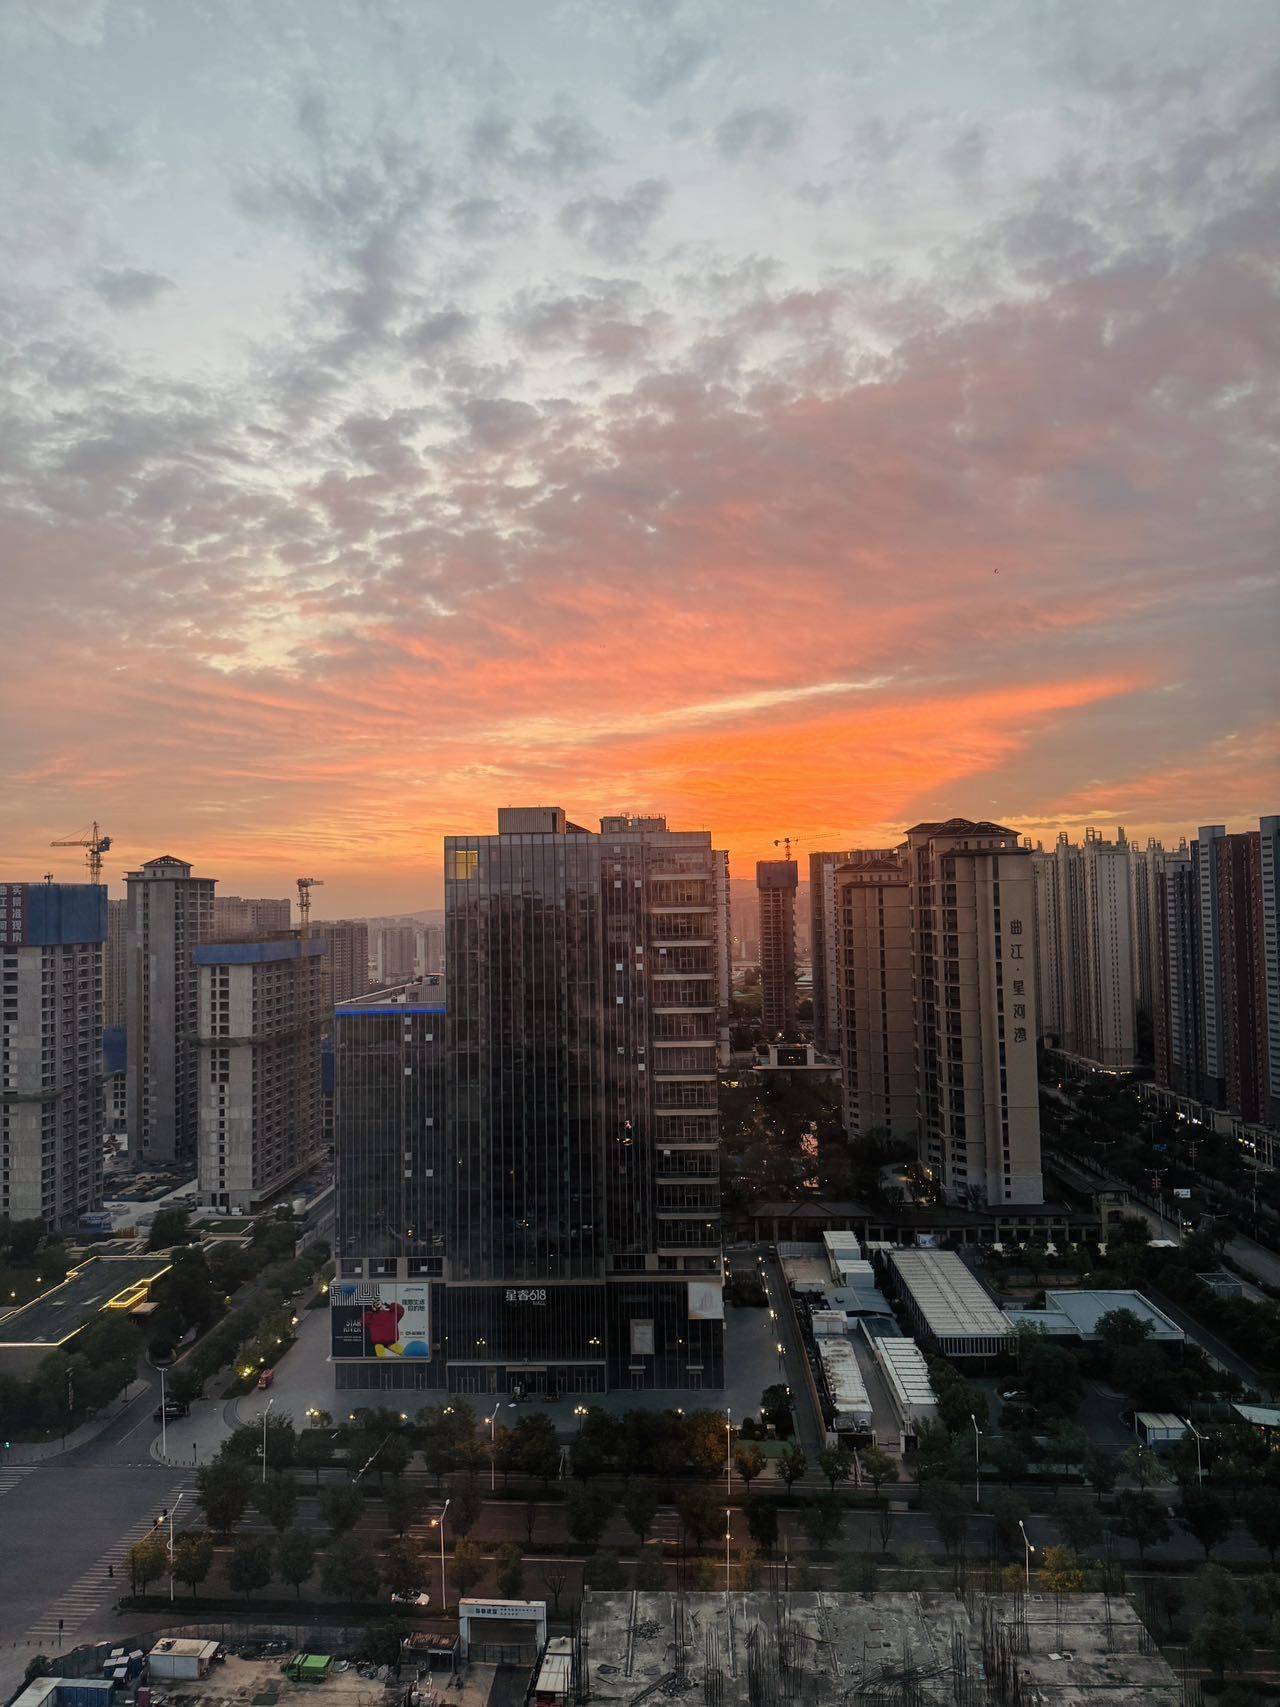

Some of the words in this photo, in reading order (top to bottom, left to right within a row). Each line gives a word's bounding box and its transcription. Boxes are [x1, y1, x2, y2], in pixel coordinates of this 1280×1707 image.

[1010, 919, 1027, 1043] 曲江·星河湾
